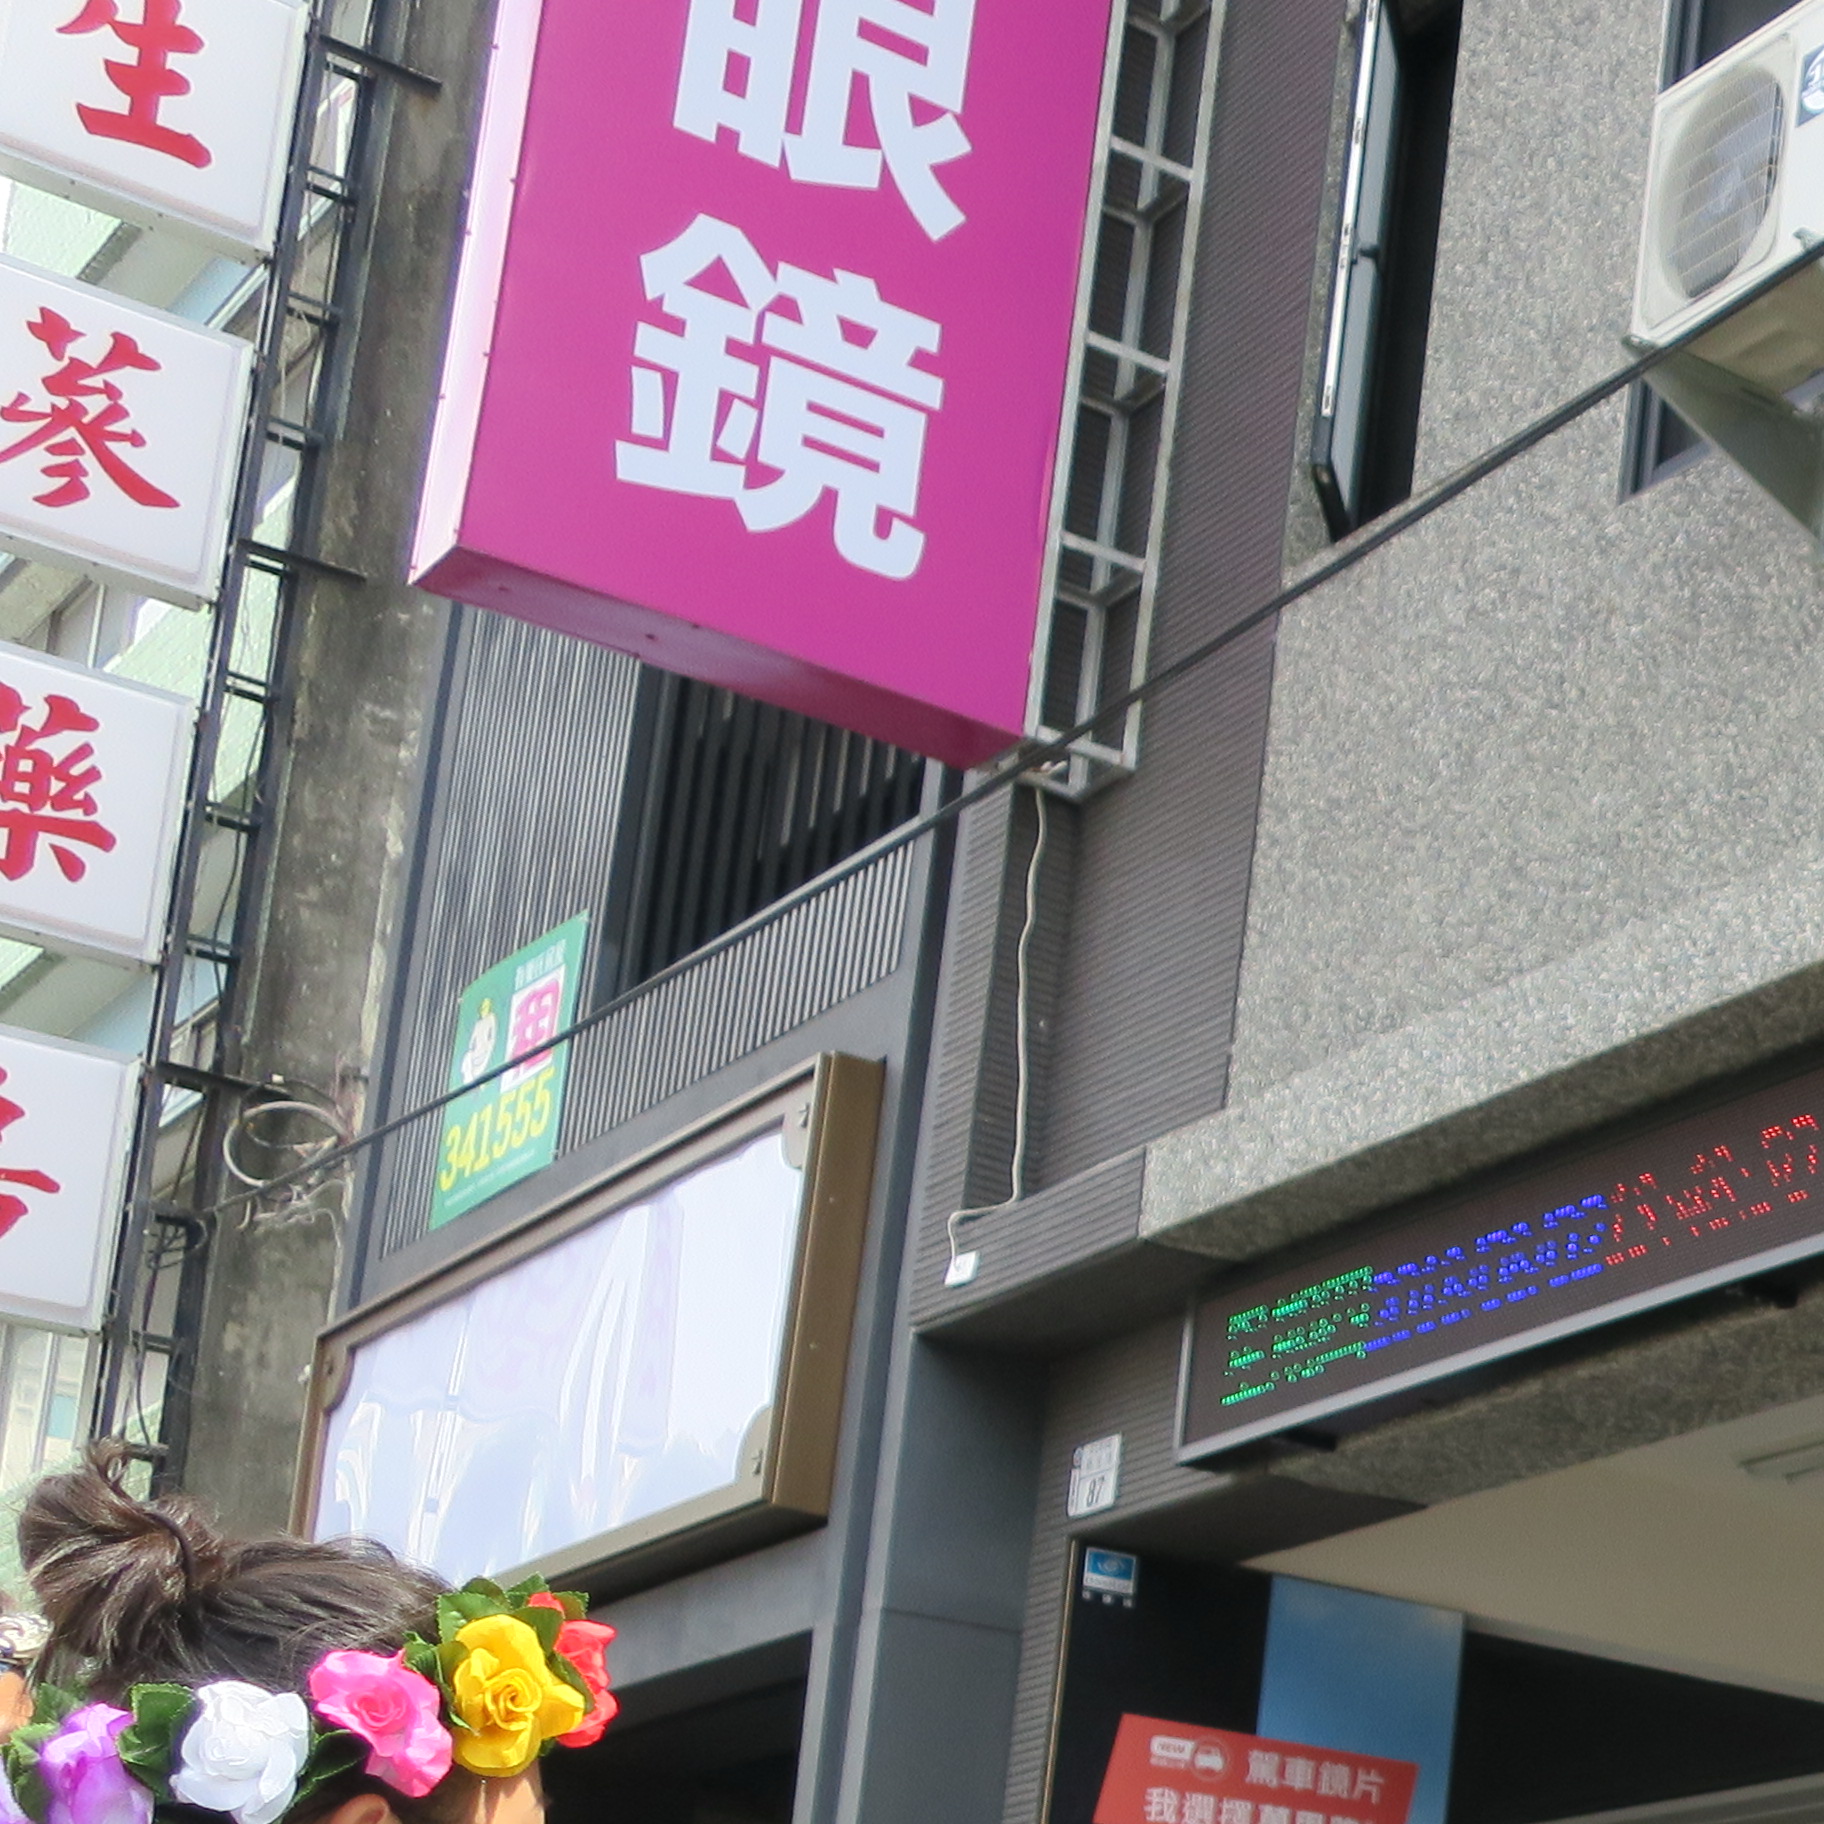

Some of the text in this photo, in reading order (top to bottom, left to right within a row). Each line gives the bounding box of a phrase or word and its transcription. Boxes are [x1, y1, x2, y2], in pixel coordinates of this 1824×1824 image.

[440, 1066, 556, 1192] 341555
[1246, 1750, 1385, 1804] 駕車鏡片
